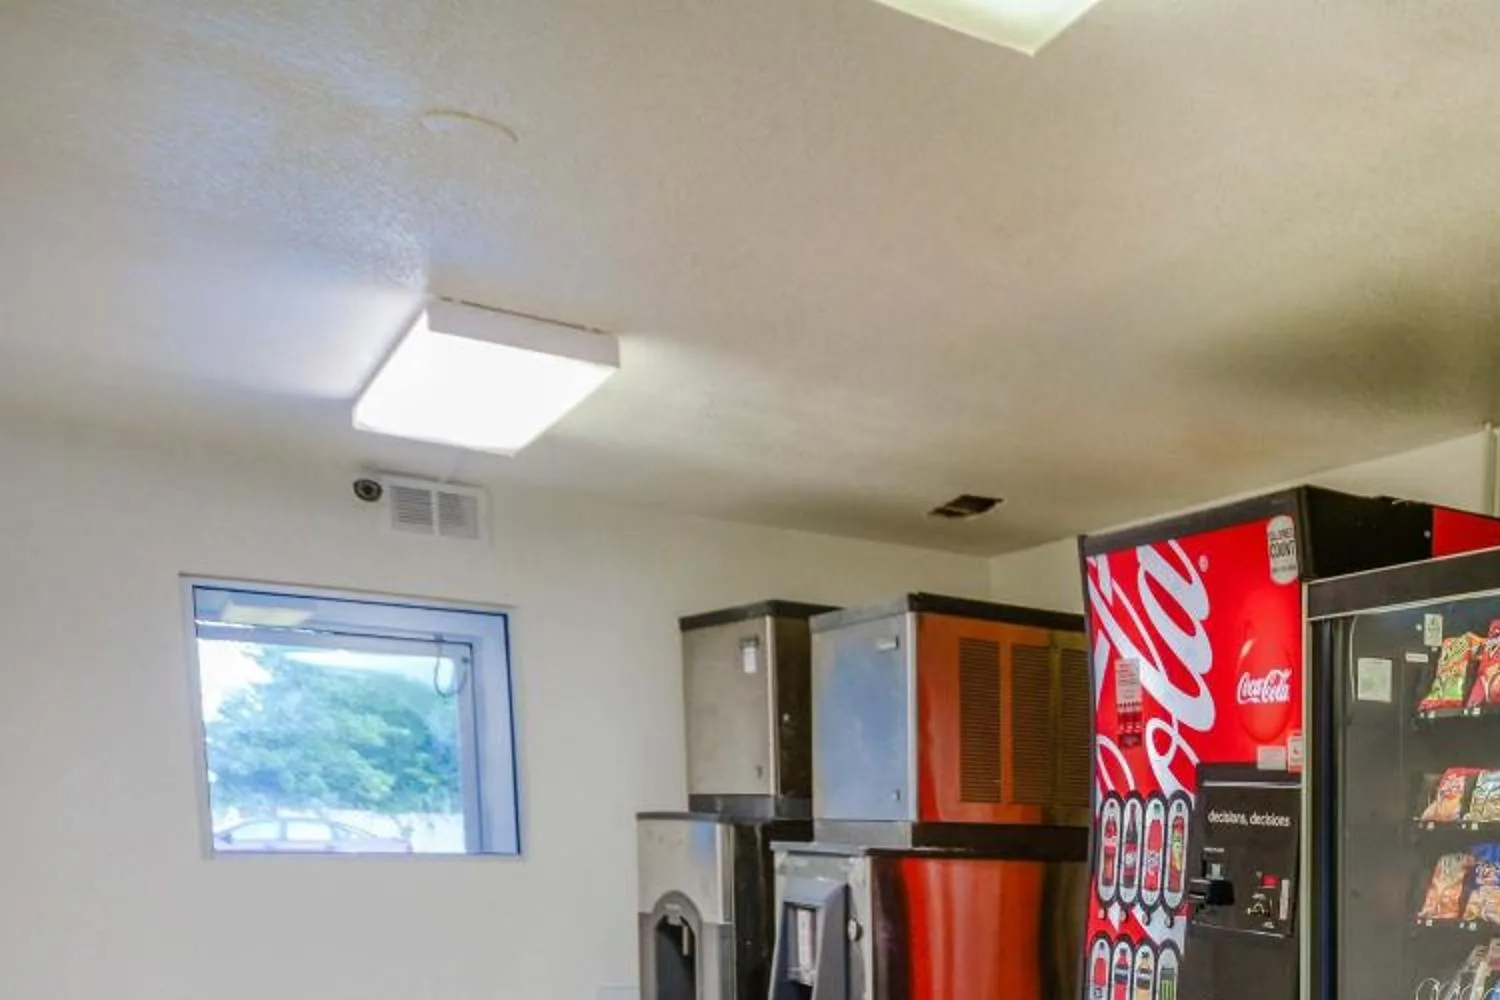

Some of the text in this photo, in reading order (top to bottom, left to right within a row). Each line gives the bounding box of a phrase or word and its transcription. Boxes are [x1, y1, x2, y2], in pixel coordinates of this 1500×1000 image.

[1237, 669, 1293, 704] Coca-Cola
[1207, 808, 1291, 827] decisions, decisions
